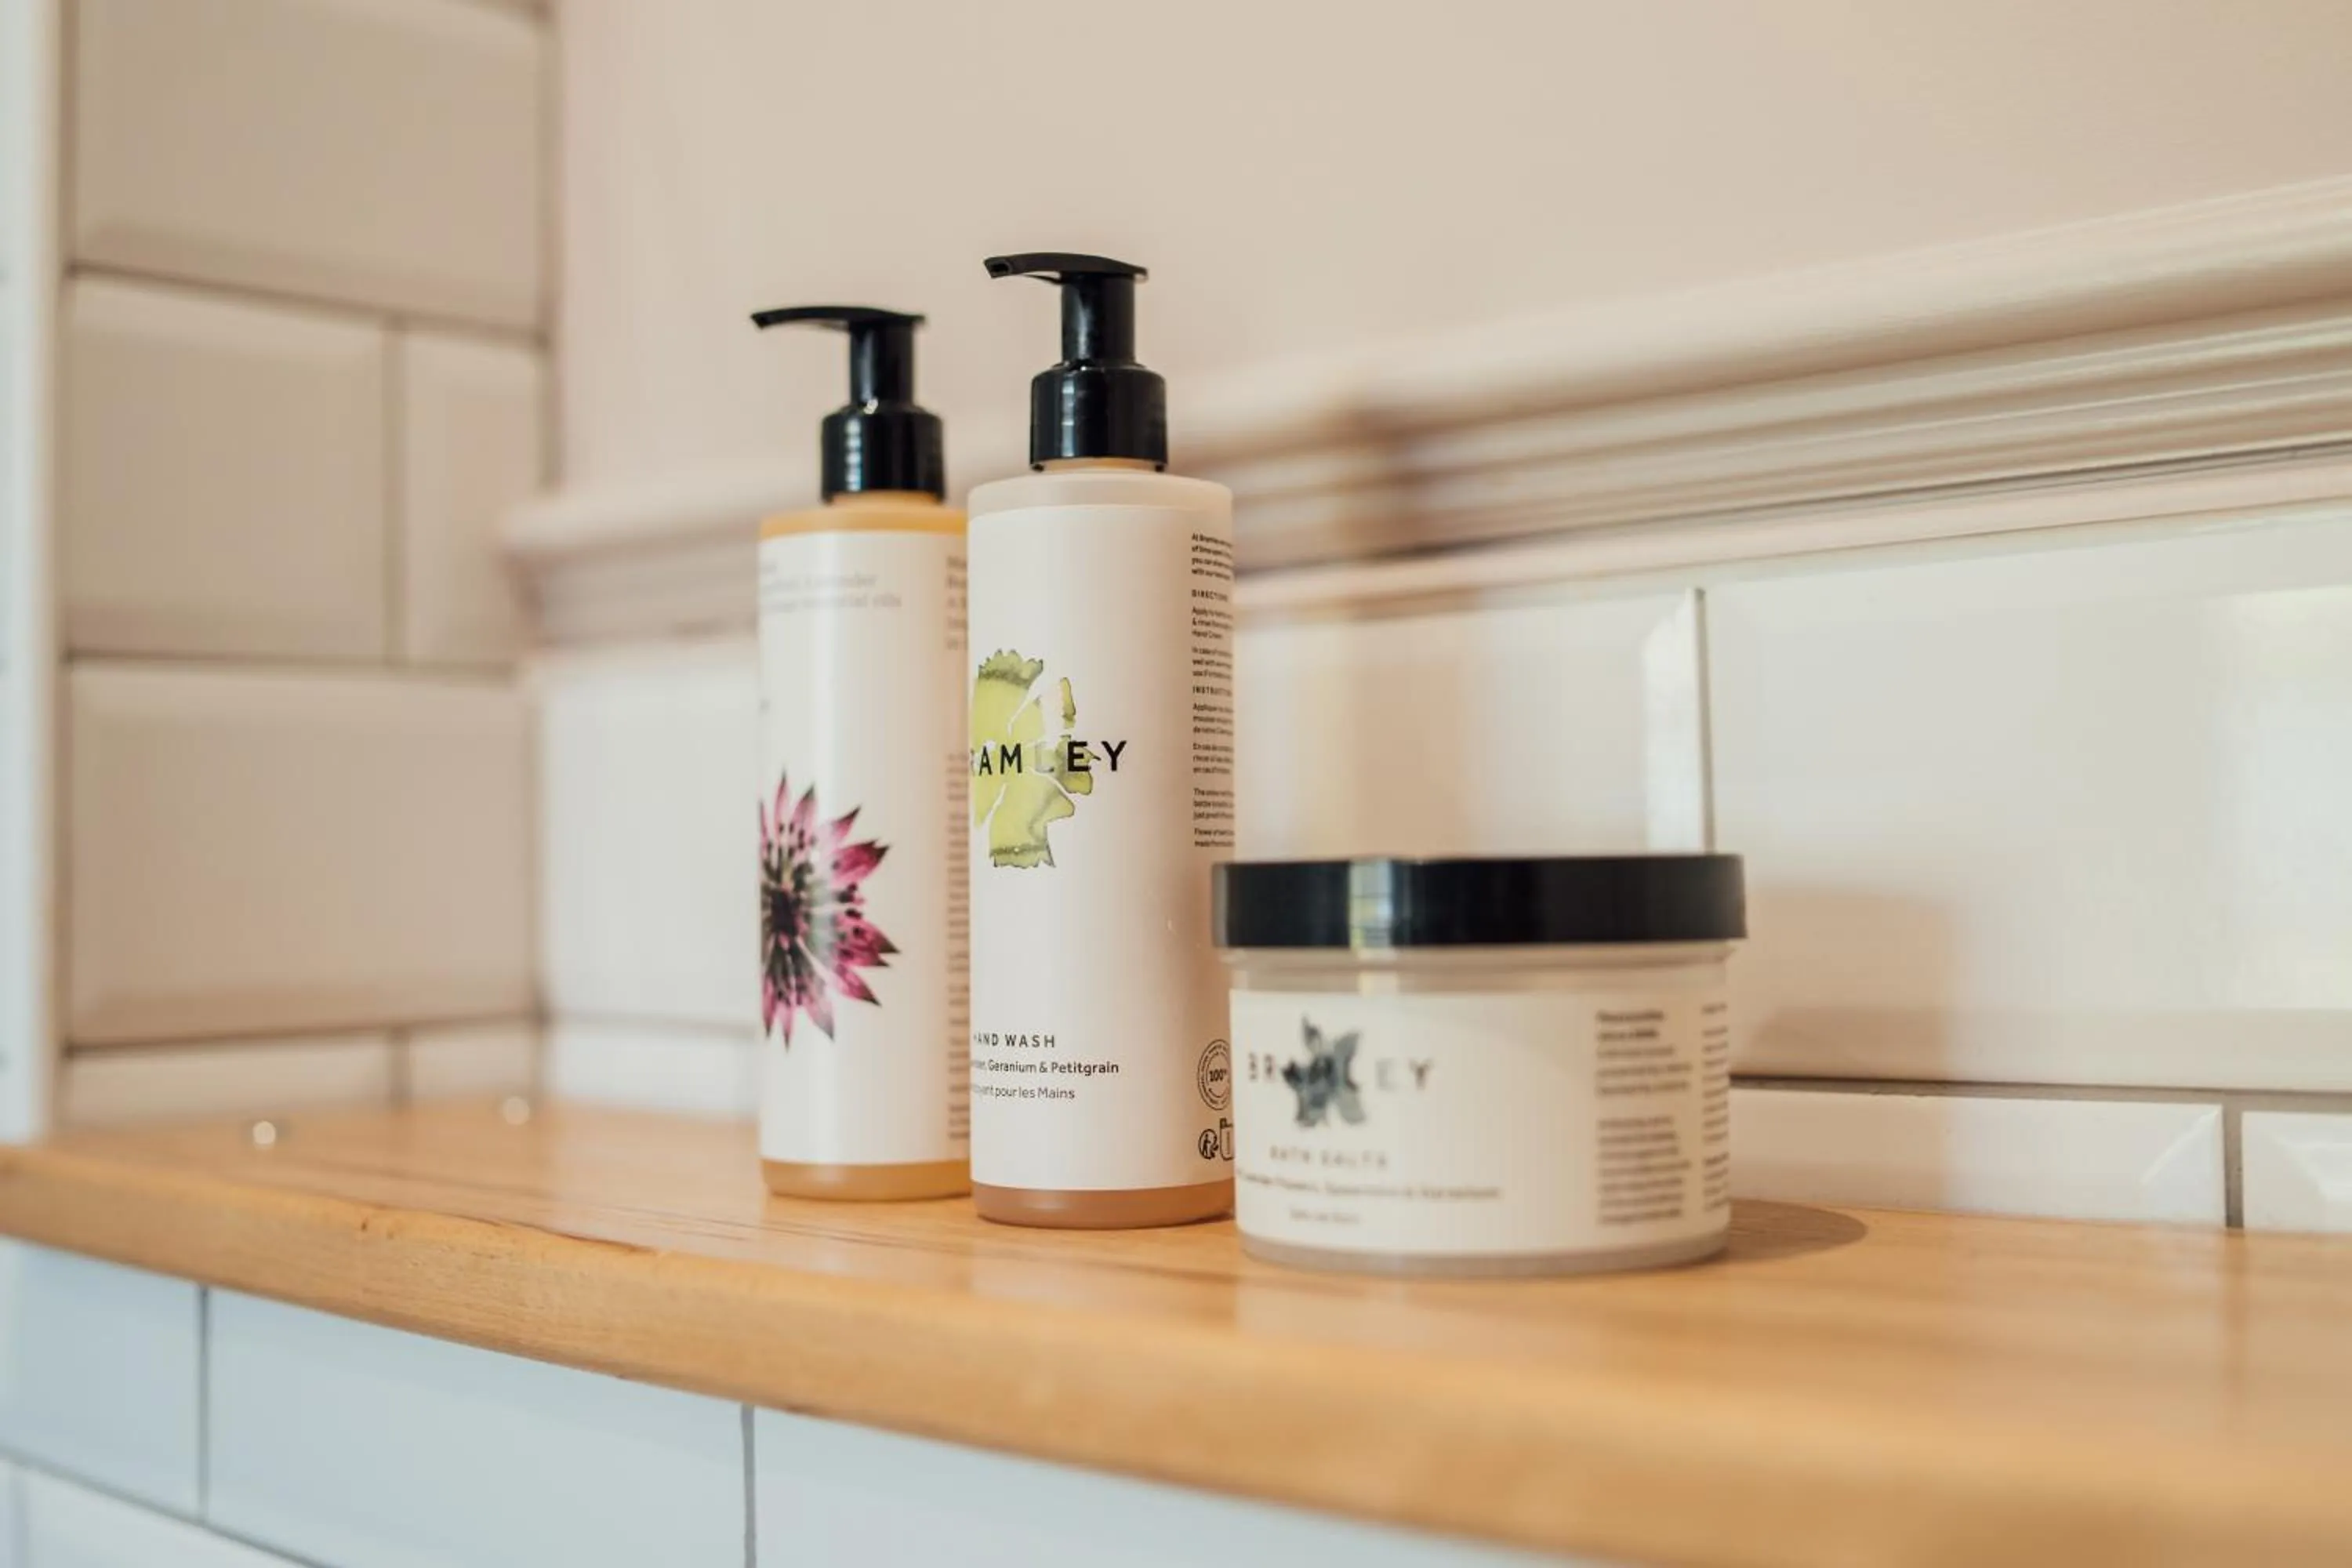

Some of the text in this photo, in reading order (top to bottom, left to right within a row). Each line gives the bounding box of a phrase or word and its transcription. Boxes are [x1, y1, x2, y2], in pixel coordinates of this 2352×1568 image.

[1004, 1034, 1055, 1049] WASH
[988, 1058, 1036, 1074] Geranium
[1039, 1060, 1050, 1073] &
[1051, 1060, 1120, 1076] Petitgrain
[995, 1087, 1017, 1100] pour
[1018, 1086, 1035, 1098] les
[1037, 1087, 1075, 1099] Mains
